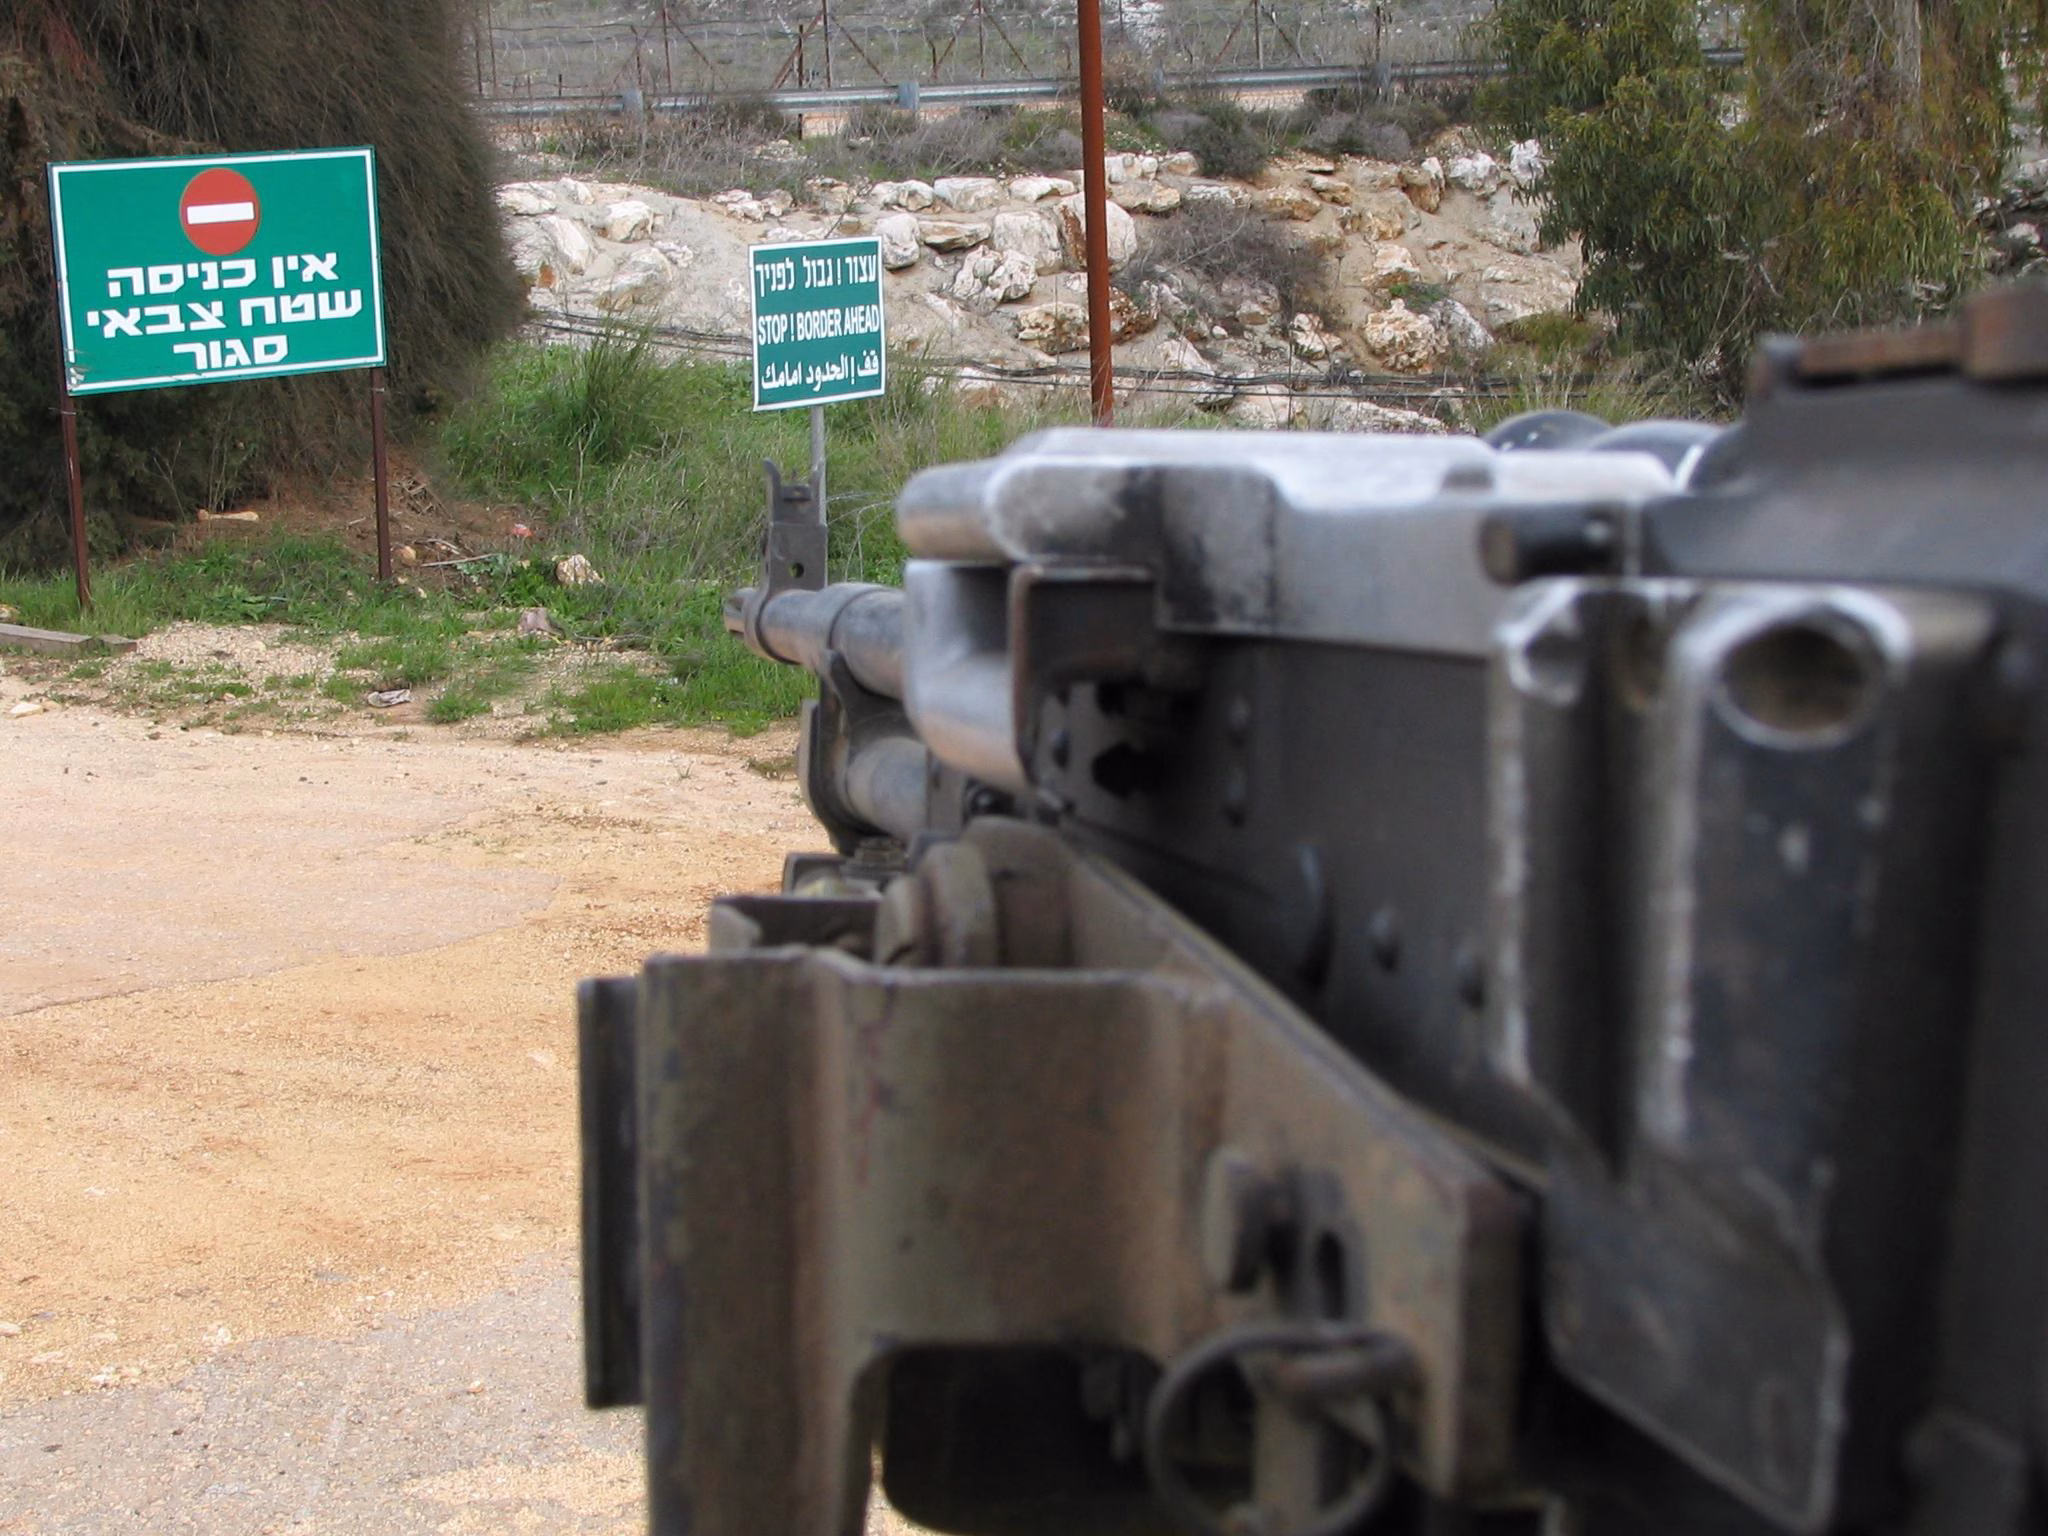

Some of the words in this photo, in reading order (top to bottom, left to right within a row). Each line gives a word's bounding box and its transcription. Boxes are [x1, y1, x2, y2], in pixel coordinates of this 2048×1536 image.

[107, 258, 257, 298] כניסה
[271, 252, 339, 289] אין
[755, 257, 795, 298] לפניך
[802, 255, 833, 289] גבול
[845, 254, 877, 285] עצור
[86, 300, 227, 339] צבאי
[239, 288, 362, 327] שטח
[758, 313, 788, 346] STOP
[796, 308, 842, 341] BORDER
[843, 304, 880, 336] AHEAD
[173, 334, 289, 370] סגור
[857, 350, 879, 377] قف
[805, 353, 849, 392] الحدود
